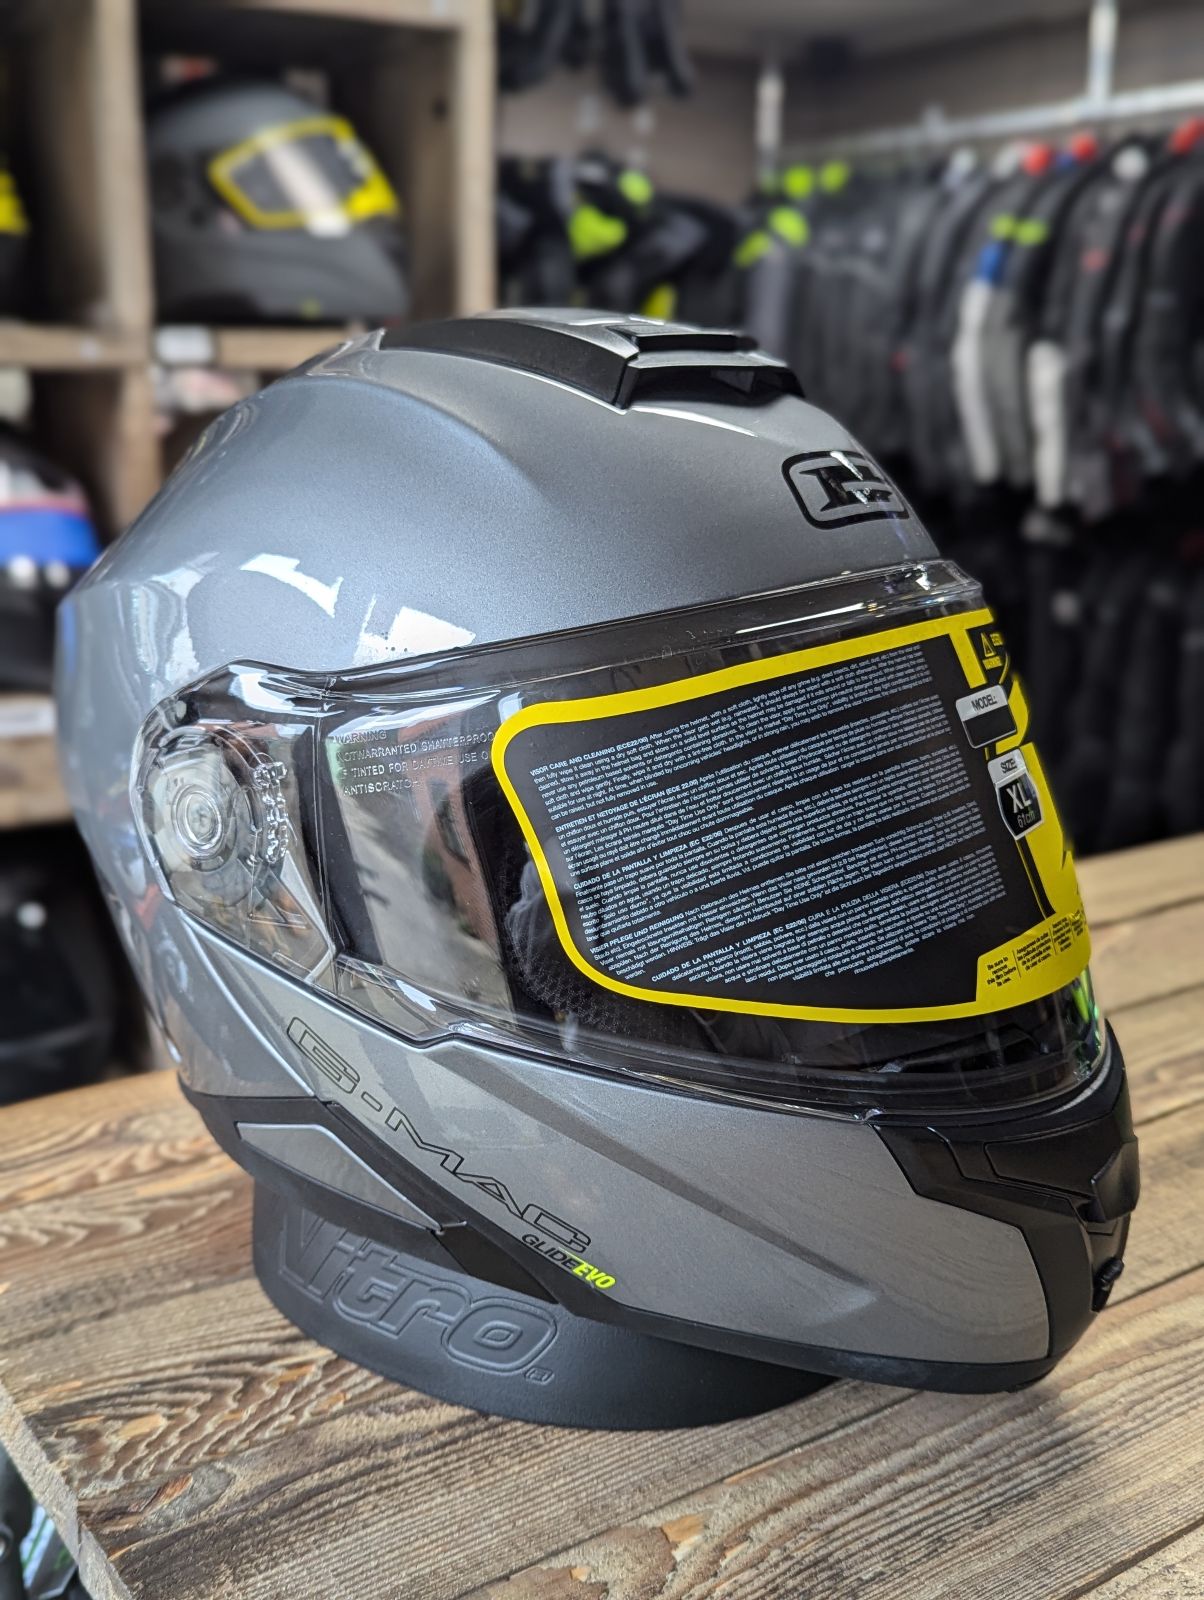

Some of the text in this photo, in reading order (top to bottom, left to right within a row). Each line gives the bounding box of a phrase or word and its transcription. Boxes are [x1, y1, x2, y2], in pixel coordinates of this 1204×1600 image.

[332, 729, 387, 745] WARNING
[421, 731, 495, 752] SHATTERPROO
[530, 766, 548, 776] VISOR
[549, 761, 568, 770] CARE
[584, 747, 615, 760] CLEANING
[649, 732, 663, 740] After
[664, 727, 679, 736] using
[710, 710, 721, 718] with
[547, 772, 558, 780] fully
[559, 768, 573, 777] wipe
[579, 761, 593, 769] clean
[595, 757, 609, 766] using
[655, 736, 671, 746] When
[683, 728, 696, 736] visor
[697, 723, 709, 732] gets
[561, 775, 574, 783] stow
[580, 770, 594, 778] away
[611, 758, 629, 767] helmet
[655, 745, 669, 754] store
[684, 735, 696, 743] solid
[697, 730, 709, 739] level
[711, 723, 730, 733] surface
[351, 764, 385, 778] TINTED
[388, 761, 408, 774] FOR
[459, 751, 478, 764] USE
[542, 790, 556, 798] never
[578, 774, 604, 787] petroleum
[605, 768, 622, 777] based
[623, 761, 645, 771] solvents
[653, 748, 682, 763] detergents
[683, 738, 711, 752] containing
[548, 802, 567, 813] suitable
[629, 777, 643, 785] when
[644, 770, 664, 780] blinded
[673, 757, 700, 772] oncoming
[556, 793, 568, 801] cloth
[581, 785, 594, 794] wipe
[632, 768, 645, 777] wipe
[605, 794, 616, 803] fully
[616, 786, 640, 798] removed
[1006, 782, 1032, 814] XL
[555, 818, 587, 832] ENTRETIEN
[680, 813, 693, 821] Time
[1016, 810, 1036, 829] 61cm
[574, 876, 600, 890] CUIDADO
[622, 857, 651, 872] PANTALLA
[659, 844, 687, 858] LIMPIEZA
[625, 871, 639, 880] trapo
[590, 943, 609, 954] VISIER
[610, 933, 633, 946] PFLEGE
[649, 913, 684, 930] REINIGUNG
[685, 907, 699, 916] Nach
[652, 966, 679, 982] CUIDADO
[703, 945, 733, 960] PANTALLA
[742, 931, 771, 945] LIMPIEZA
[286, 1016, 591, 1253] G-MAC
